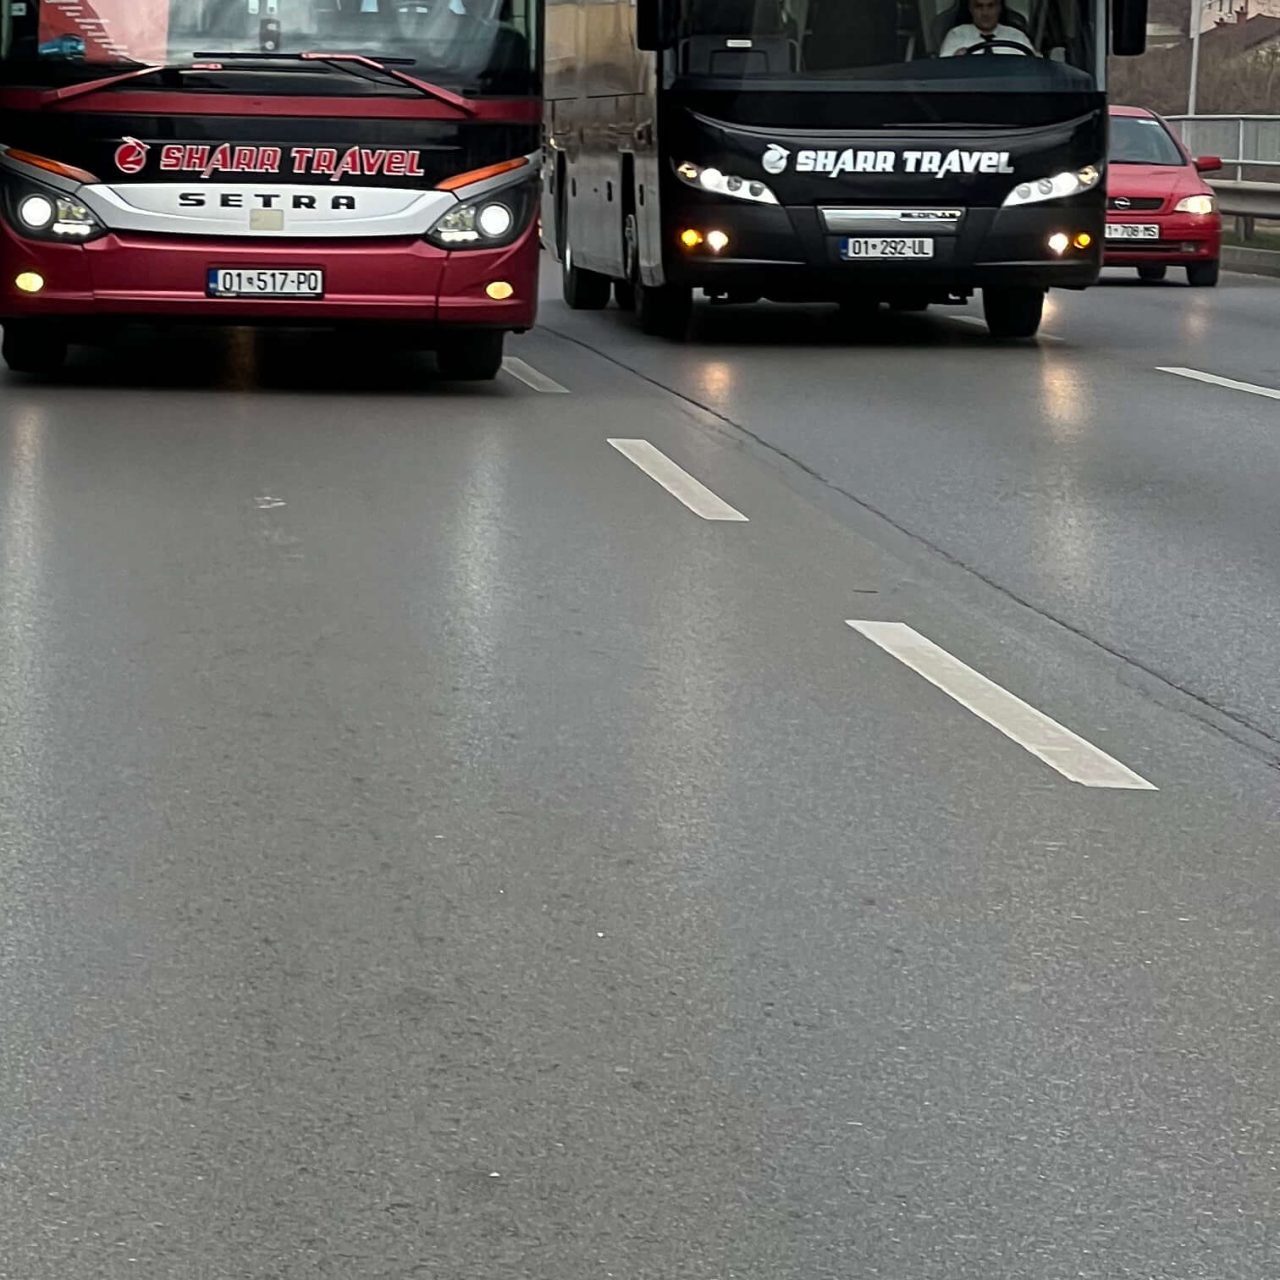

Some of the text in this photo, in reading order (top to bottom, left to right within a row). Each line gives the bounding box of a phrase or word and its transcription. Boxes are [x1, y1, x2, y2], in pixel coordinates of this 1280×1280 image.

[160, 143, 281, 178] SHARR
[795, 148, 895, 178] SHARR
[178, 193, 356, 210] SETRA
